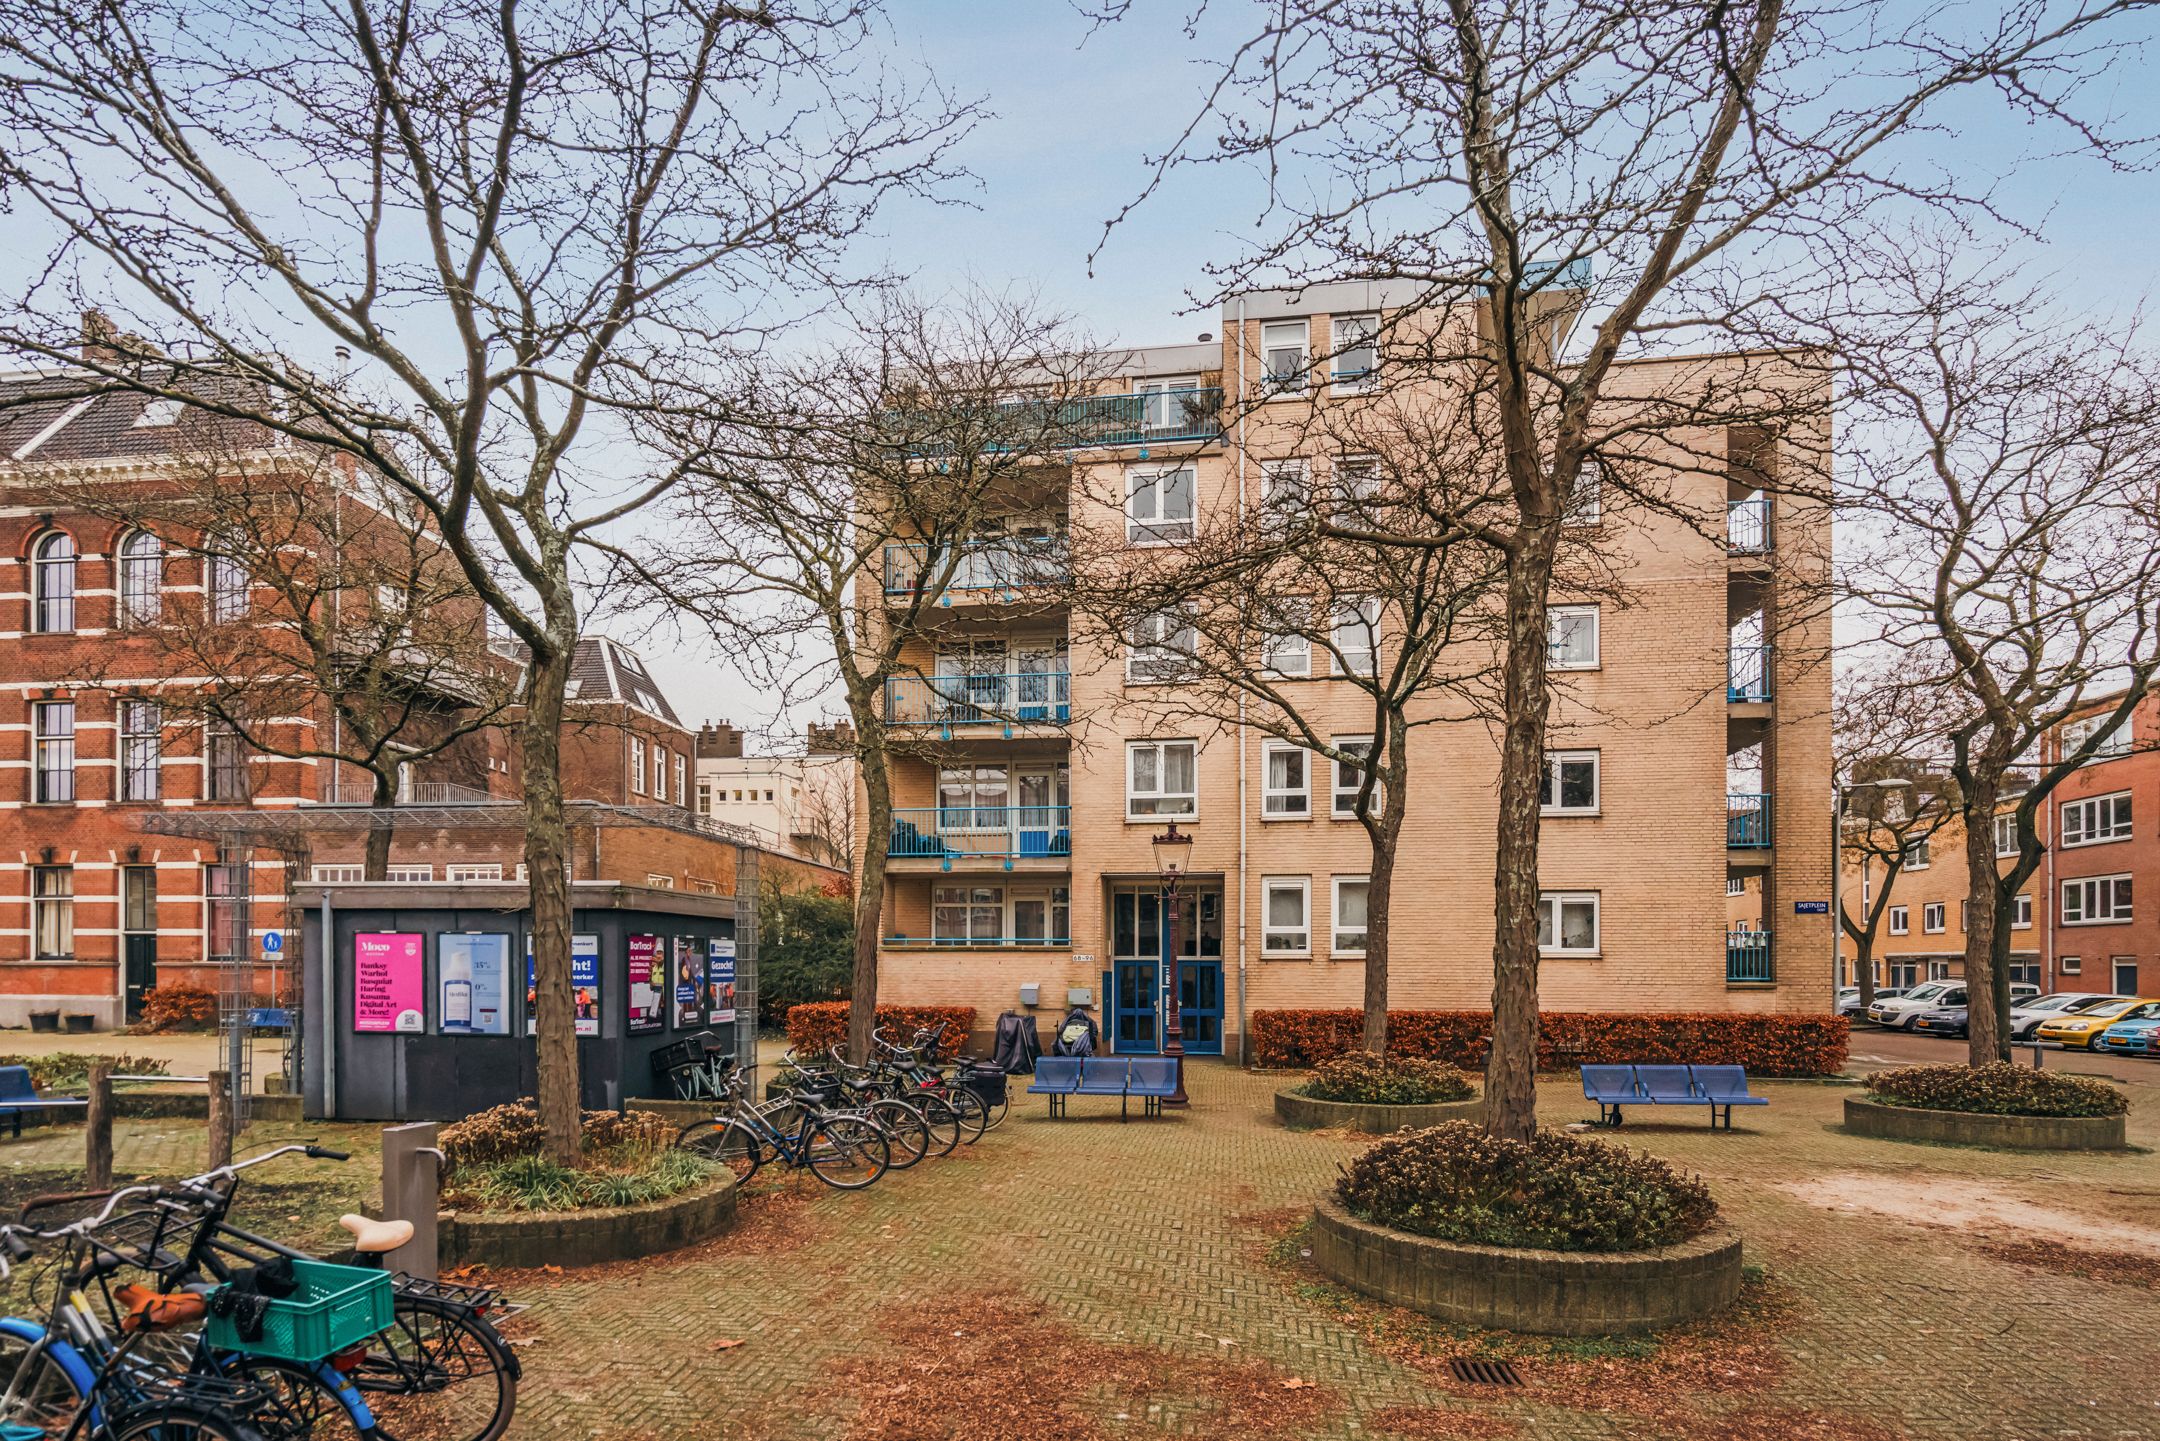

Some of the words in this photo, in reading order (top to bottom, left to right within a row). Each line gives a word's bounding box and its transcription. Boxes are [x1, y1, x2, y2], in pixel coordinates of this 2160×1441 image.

[361, 942, 390, 951] Moco
[711, 961, 734, 970] Gezocht!
[361, 978, 392, 987] Basquiat
